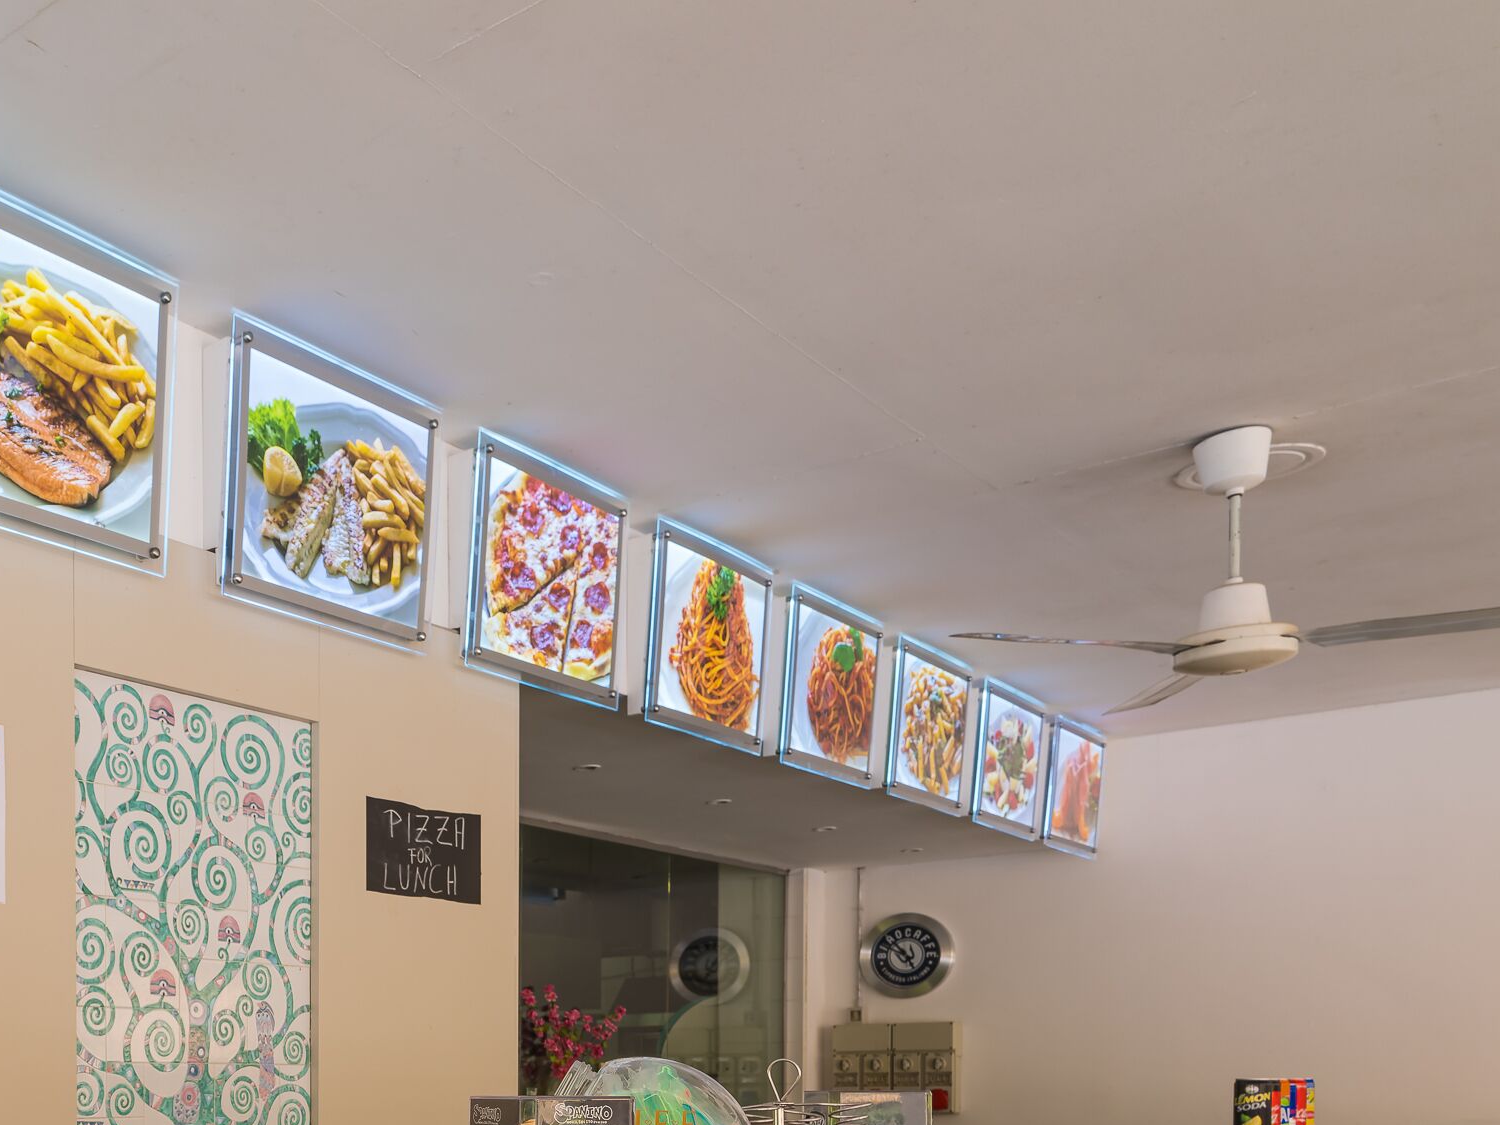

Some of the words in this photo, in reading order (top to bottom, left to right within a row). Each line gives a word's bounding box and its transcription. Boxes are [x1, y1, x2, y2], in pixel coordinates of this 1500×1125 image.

[383, 809, 465, 850] PIZZA
[407, 846, 433, 866] FOR
[383, 862, 457, 896] LUNCH
[1235, 1092, 1271, 1106] LEMON
[1236, 1101, 1267, 1112] SODA
[553, 1102, 613, 1124] SPANINO
